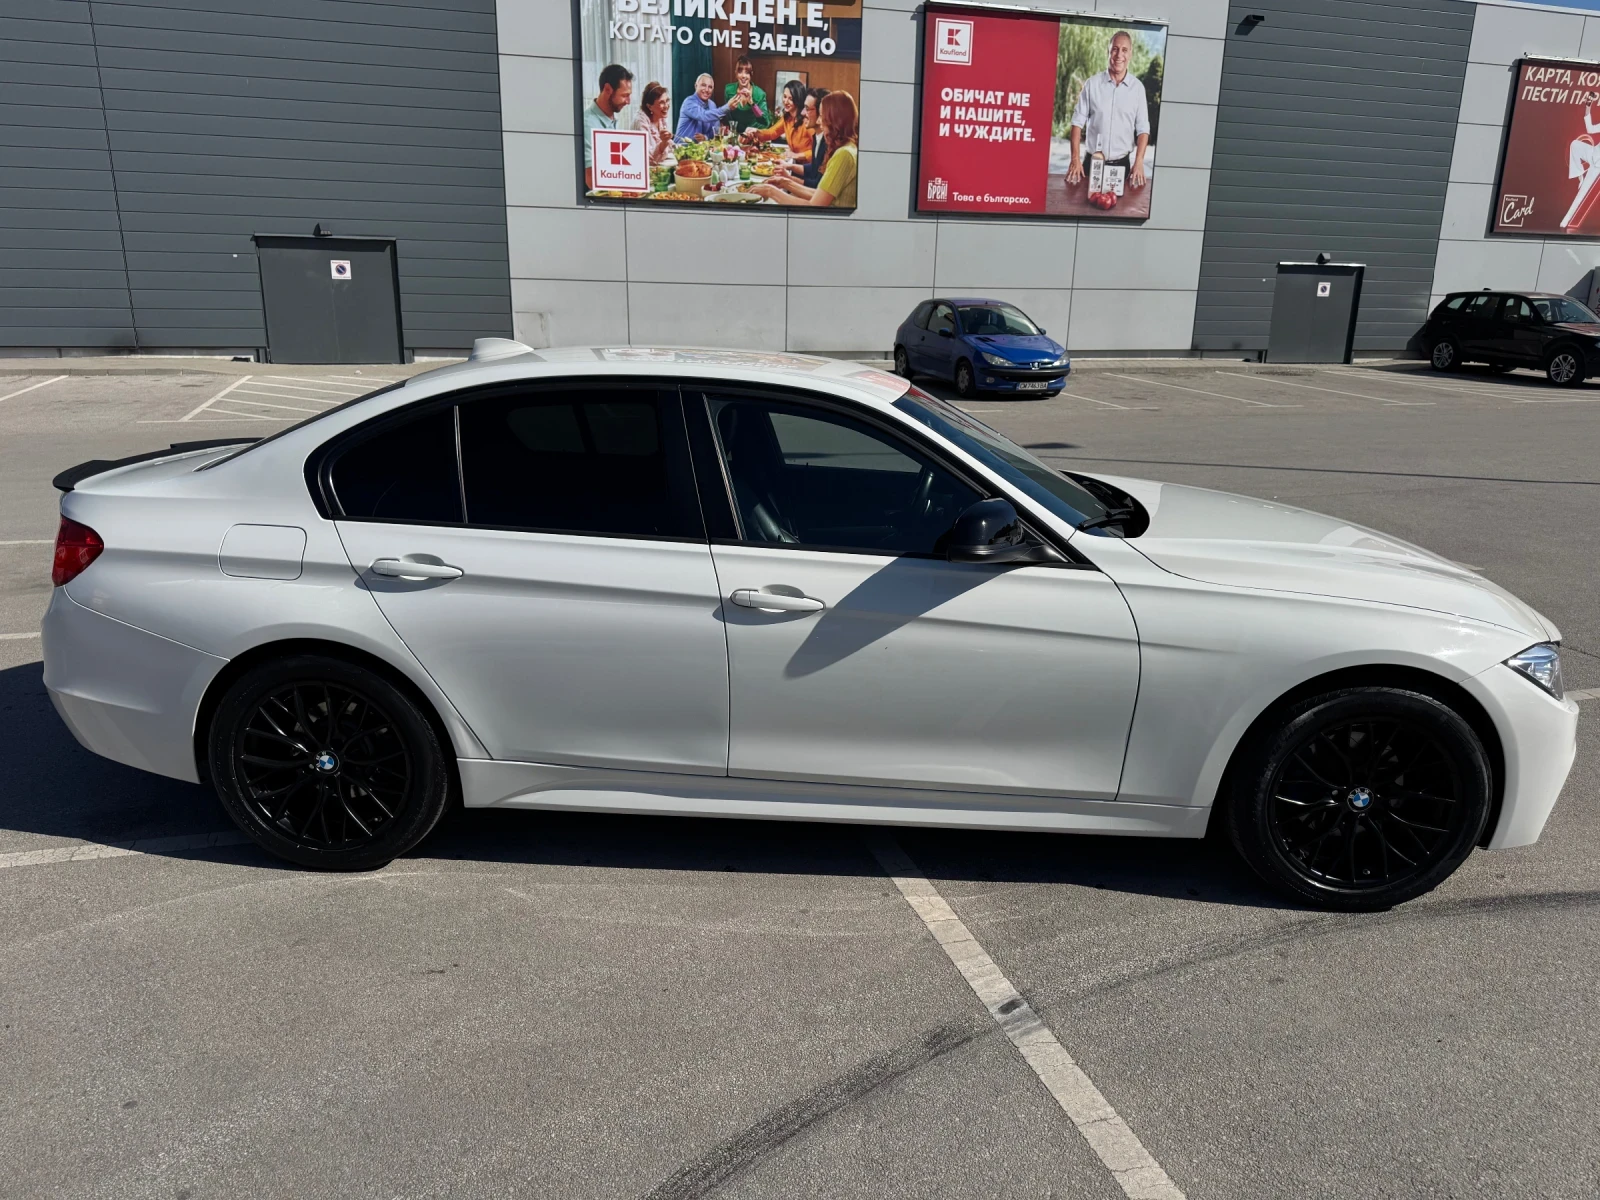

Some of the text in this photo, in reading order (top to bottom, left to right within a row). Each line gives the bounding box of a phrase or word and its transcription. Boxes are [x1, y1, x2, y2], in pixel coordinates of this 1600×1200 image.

[807, 1, 829, 31] Е,
[609, 21, 836, 56] КОГАТО СМЕ ЗАЕДНО
[940, 48, 967, 56] Kaufland
[1525, 66, 1574, 87] КАРТА,
[941, 87, 1030, 107] ОБИЧАТ МЕ
[1522, 86, 1600, 107] ПЕСТИ ПАР
[940, 105, 1026, 126] И НАШИТЕ,
[939, 122, 1035, 142] И ЧУЖДИТЕ.
[600, 169, 642, 180] Kaufland
[952, 192, 974, 202] Това
[983, 193, 1032, 205] българско.
[1503, 196, 1535, 223] Card
